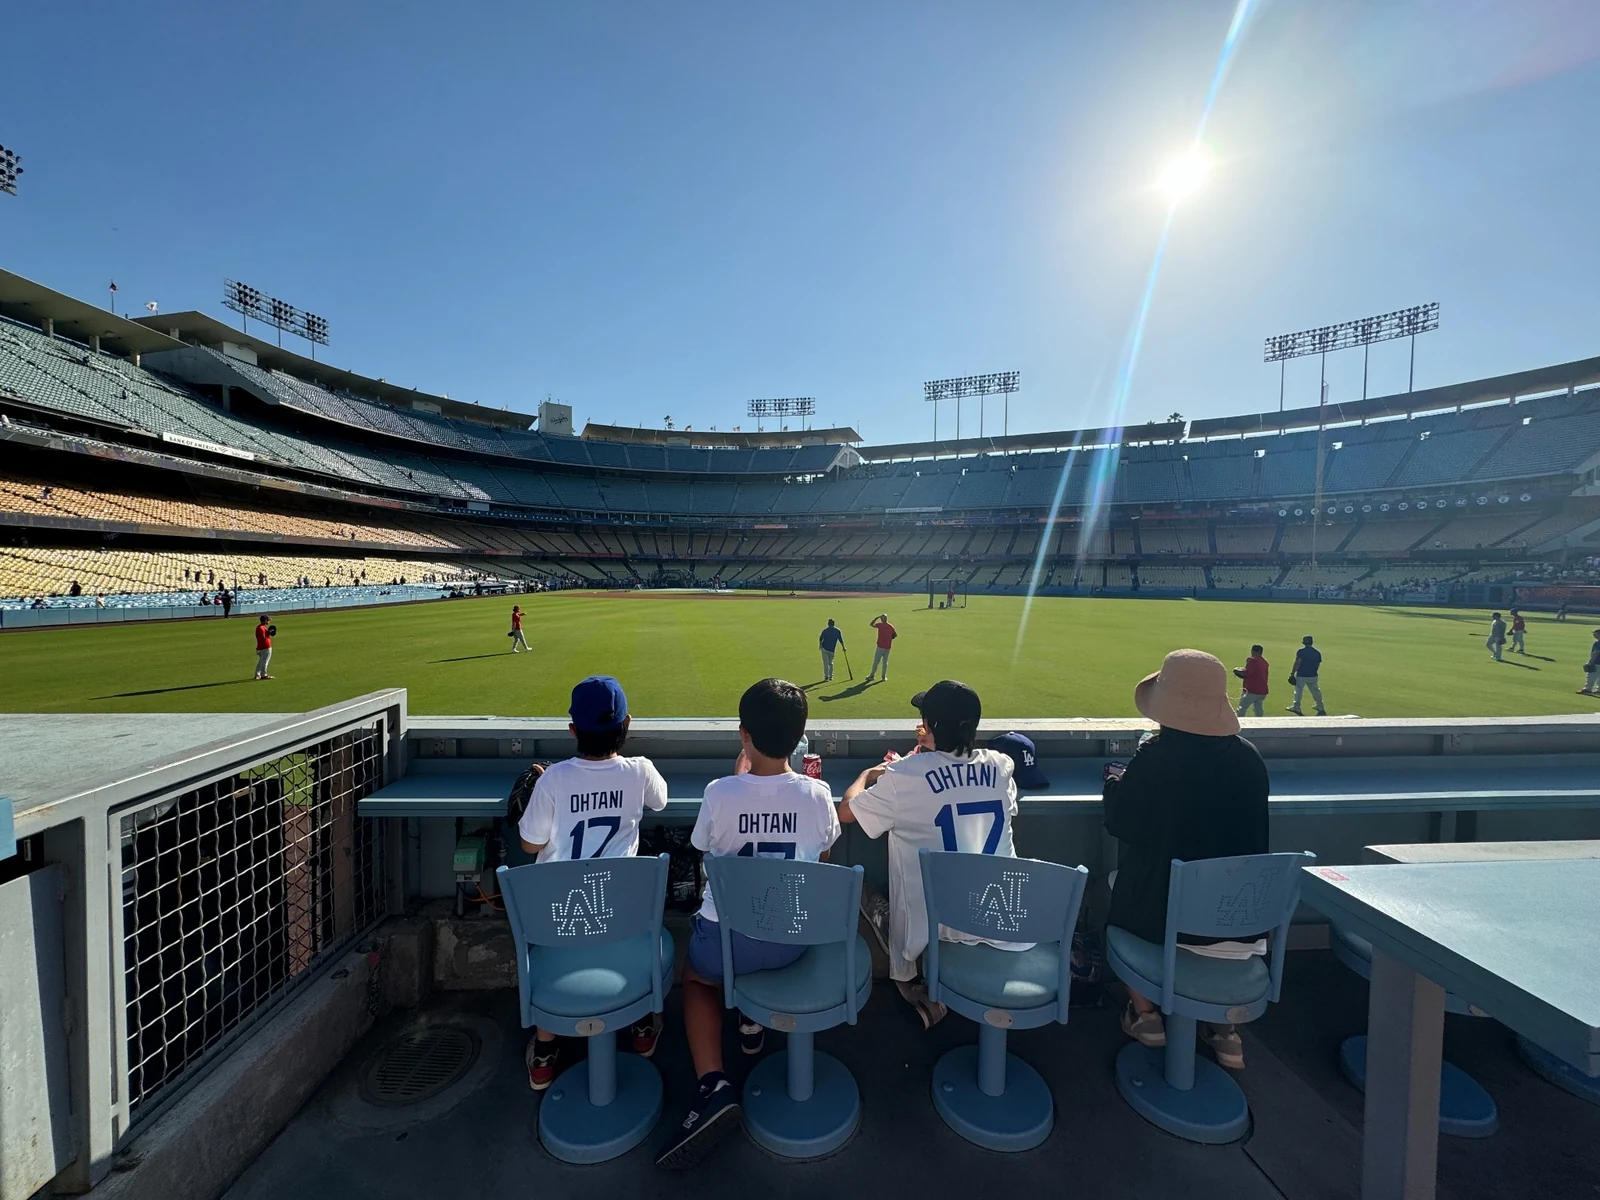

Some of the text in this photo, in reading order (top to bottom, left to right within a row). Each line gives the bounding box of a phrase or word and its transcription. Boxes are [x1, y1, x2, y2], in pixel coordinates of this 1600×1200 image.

[169, 436, 185, 445] BANK
[194, 443, 218, 452] AMERICA
[1022, 750, 1035, 767] LA
[924, 762, 998, 795] OHTANI
[570, 789, 624, 813] OHTANI
[738, 812, 798, 834] OHTANI
[933, 799, 1006, 855] 17
[569, 815, 622, 860] 17
[588, 1022, 593, 1031] 1
